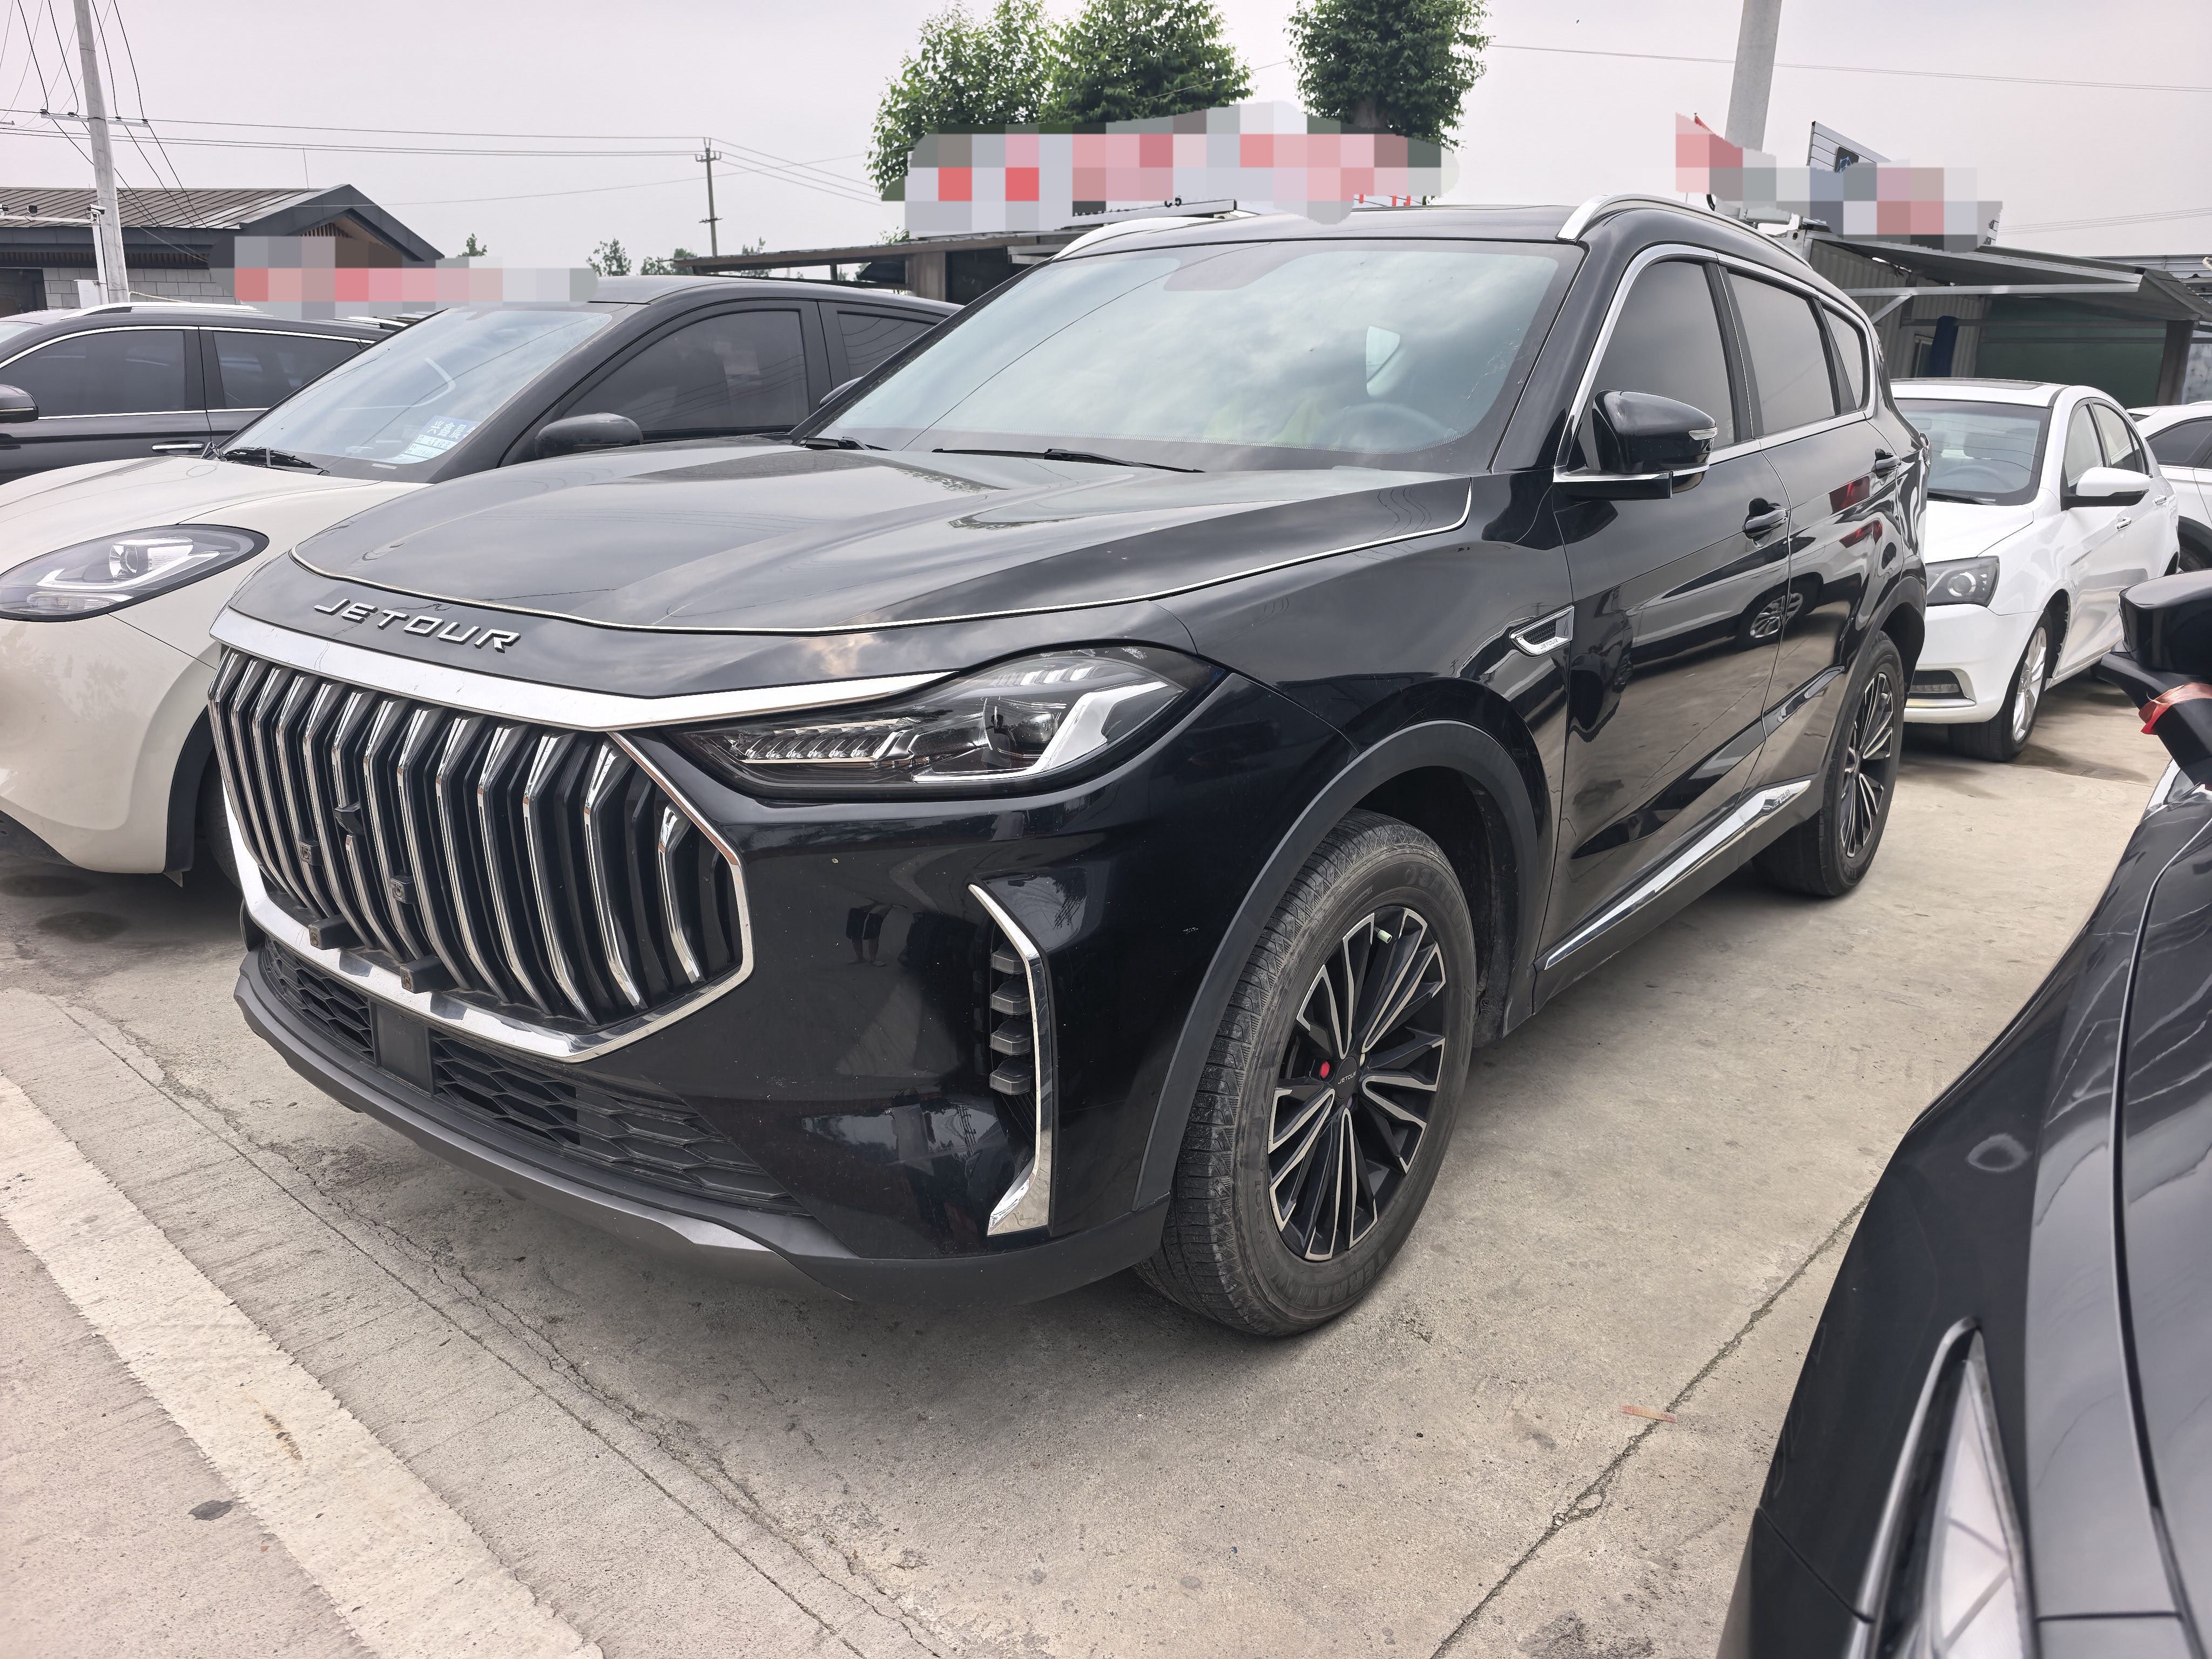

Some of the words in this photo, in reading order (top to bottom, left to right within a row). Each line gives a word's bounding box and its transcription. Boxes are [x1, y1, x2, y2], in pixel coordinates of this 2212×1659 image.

[427, 420, 476, 440] 兴鑫晨
[313, 598, 522, 653] JETOUR
[1540, 638, 1559, 650] JETOUR
[1338, 1071, 1357, 1084] JETOUR
